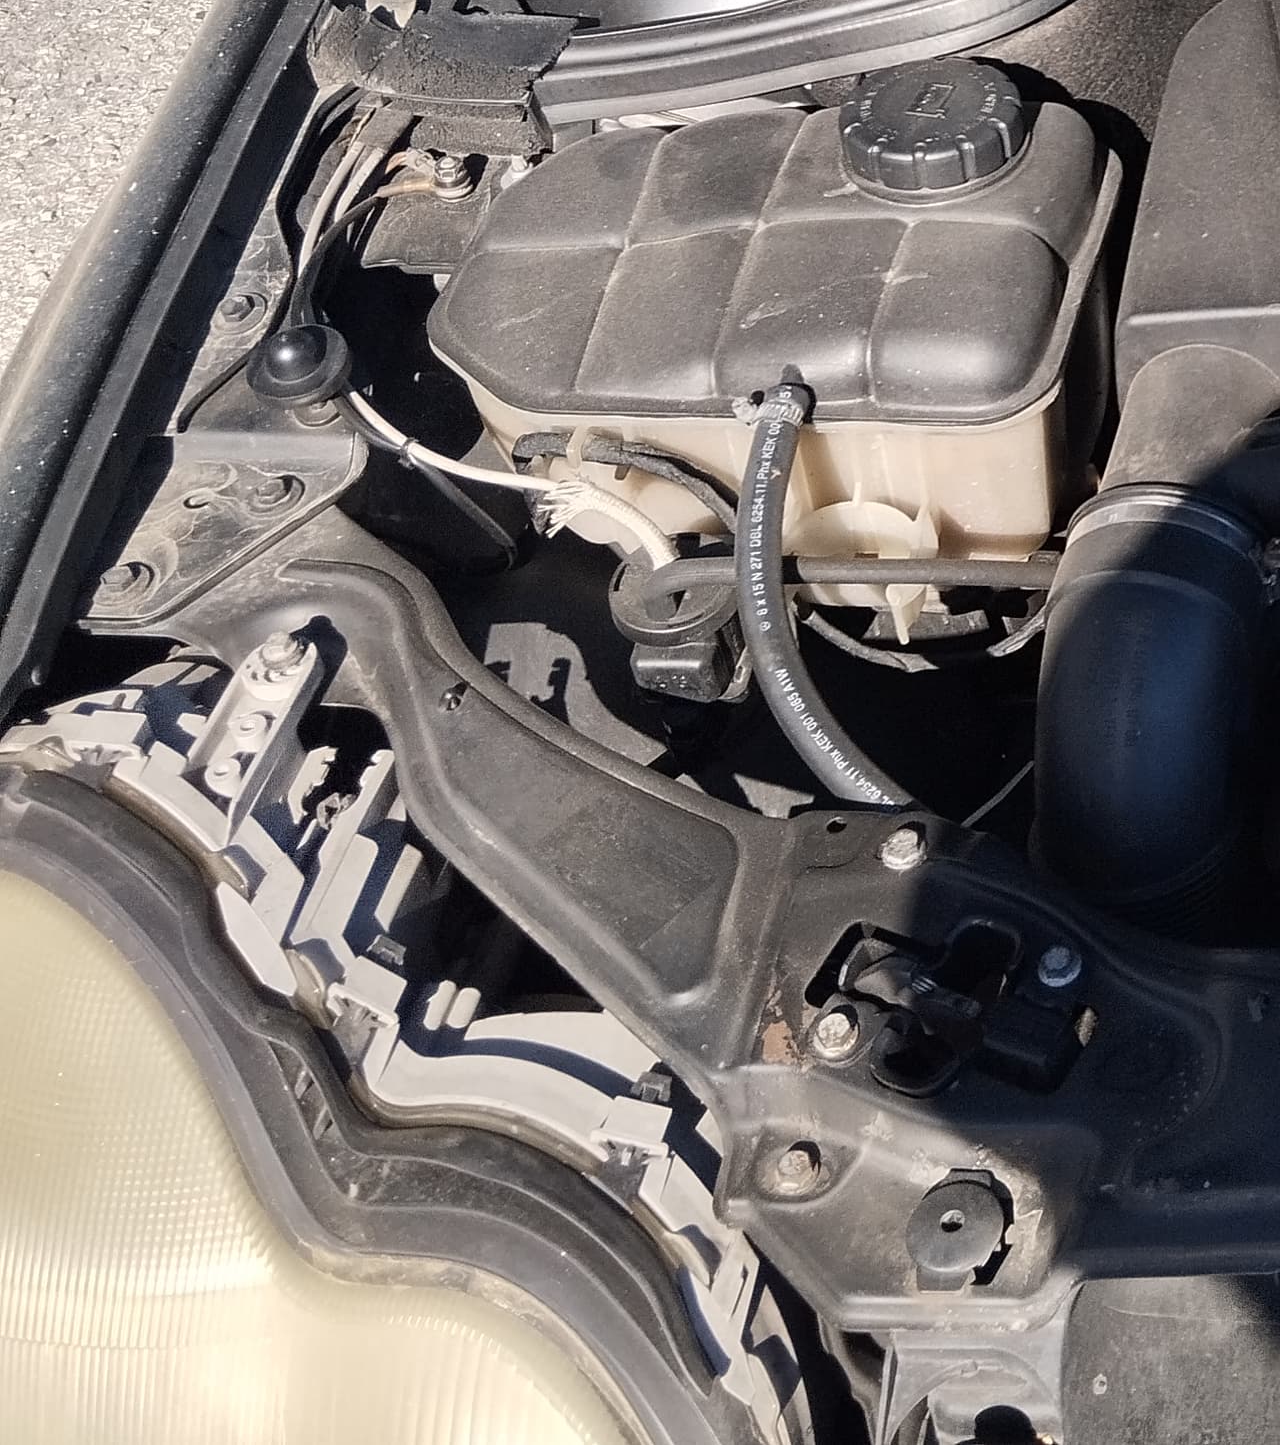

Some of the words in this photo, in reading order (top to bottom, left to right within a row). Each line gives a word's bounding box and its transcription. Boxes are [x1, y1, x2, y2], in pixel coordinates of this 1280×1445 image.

[761, 437, 777, 459] KEK
[749, 524, 763, 548] DBL
[749, 551, 763, 570] 271
[751, 572, 764, 582] N
[752, 583, 766, 596] 15
[786, 692, 805, 712] 065
[800, 712, 818, 731] 001
[810, 728, 833, 752] KEK
[830, 748, 849, 770] Phx
